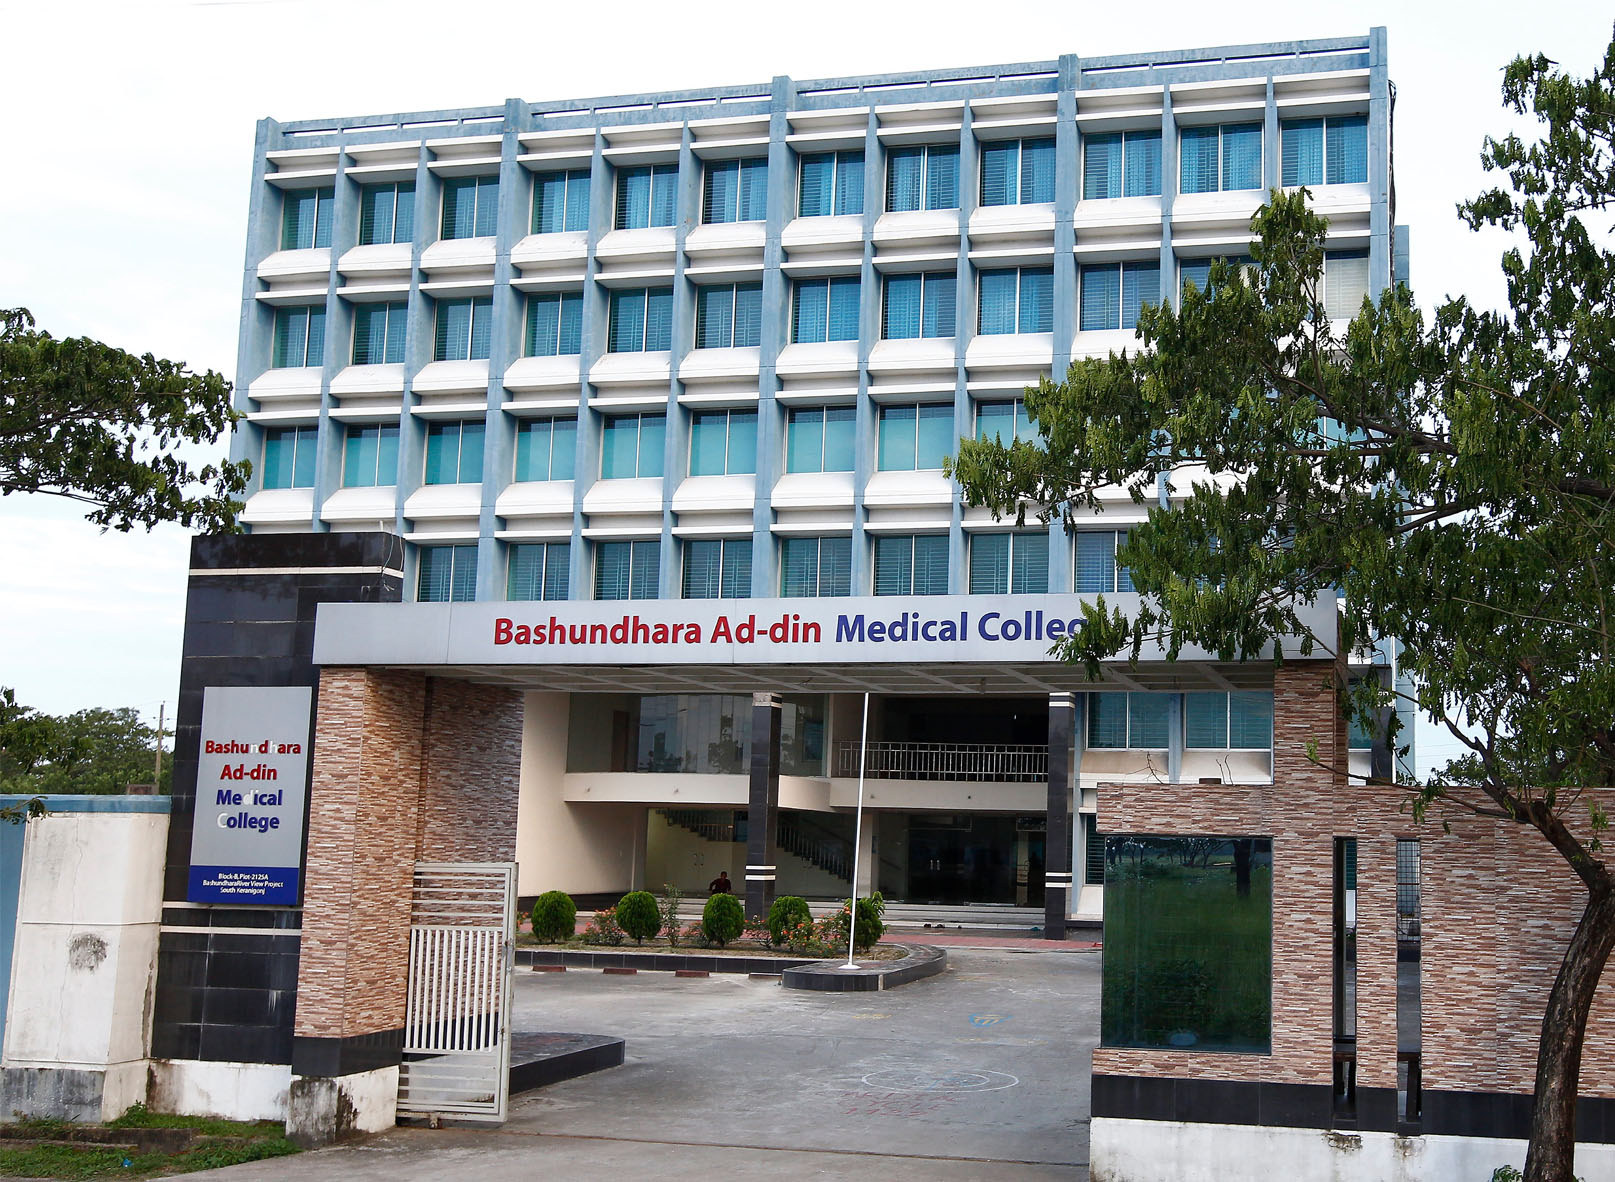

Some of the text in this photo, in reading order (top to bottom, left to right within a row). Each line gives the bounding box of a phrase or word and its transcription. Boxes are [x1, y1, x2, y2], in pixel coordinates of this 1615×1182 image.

[494, 615, 702, 645] Bashundhara
[710, 613, 821, 643] Ad-din
[835, 611, 968, 642] Medical
[205, 740, 301, 754] Bashundhara
[220, 764, 277, 780] Ad-din
[216, 789, 283, 805] Medical
[217, 812, 280, 833] College
